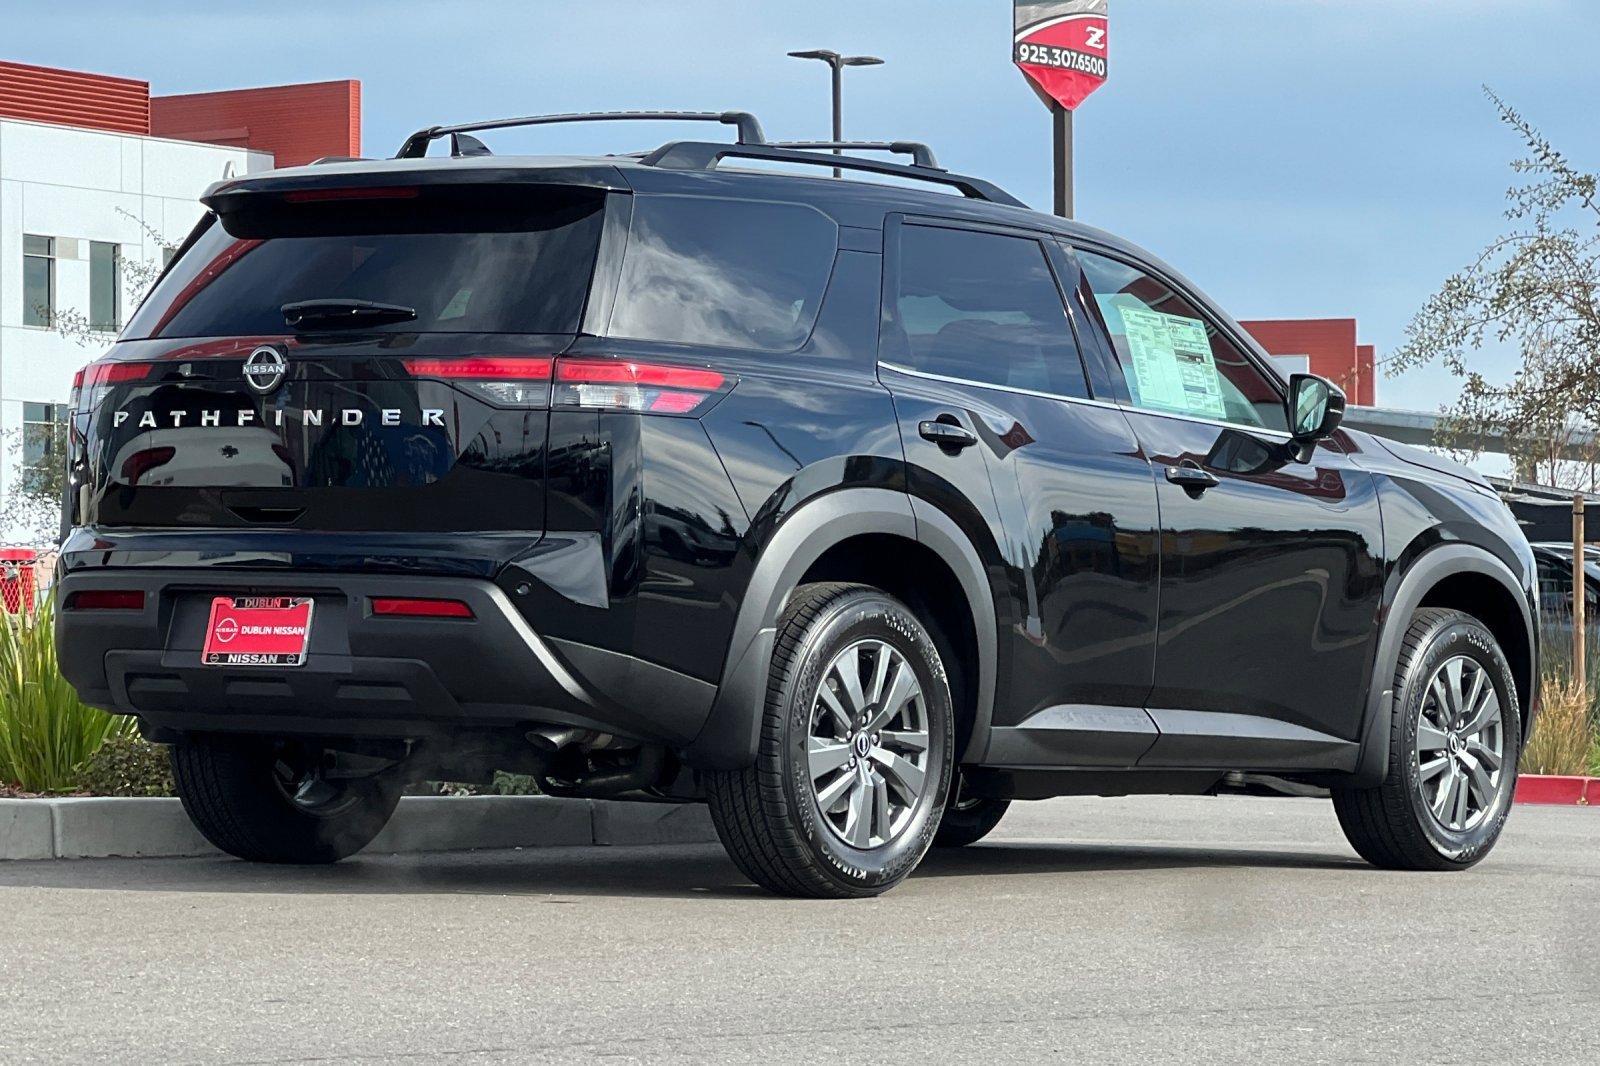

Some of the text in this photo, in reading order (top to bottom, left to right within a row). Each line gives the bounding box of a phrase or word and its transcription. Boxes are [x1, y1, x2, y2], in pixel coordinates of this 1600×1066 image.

[1019, 44, 1105, 76] 925.307.6500
[243, 365, 285, 373] NISSAN
[113, 408, 445, 428] PATHFINDER
[244, 597, 281, 608] DUBLIN
[241, 625, 305, 636] DUBLIN NISSAN
[227, 654, 278, 664] NISSAN
